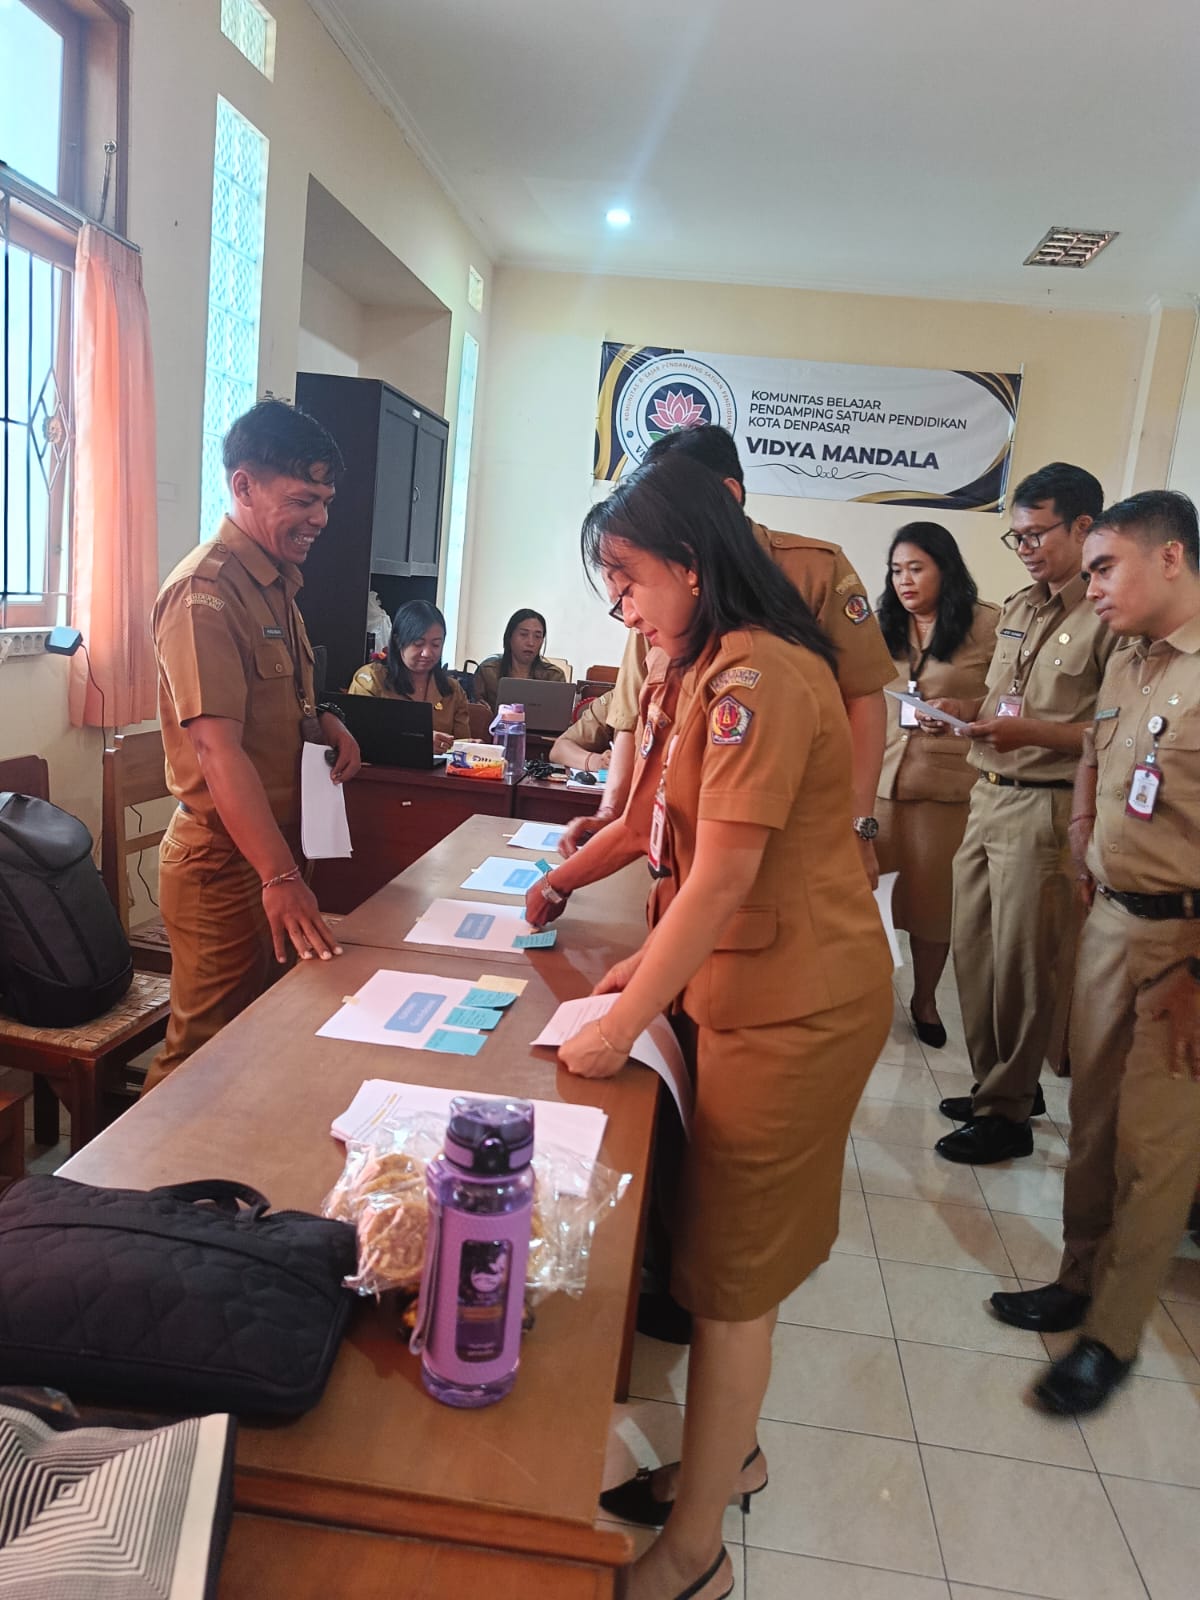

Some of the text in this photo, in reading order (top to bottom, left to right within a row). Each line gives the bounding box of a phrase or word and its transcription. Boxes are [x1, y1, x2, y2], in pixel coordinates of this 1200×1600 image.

[751, 389, 881, 410] KOMUNITAS BELAJAR
[748, 416, 851, 435] KOTA DENPASAR
[749, 402, 967, 430] PENDAMPING SATUAN PENDIDIKAN
[746, 436, 940, 470] VIDYA MANDALA
